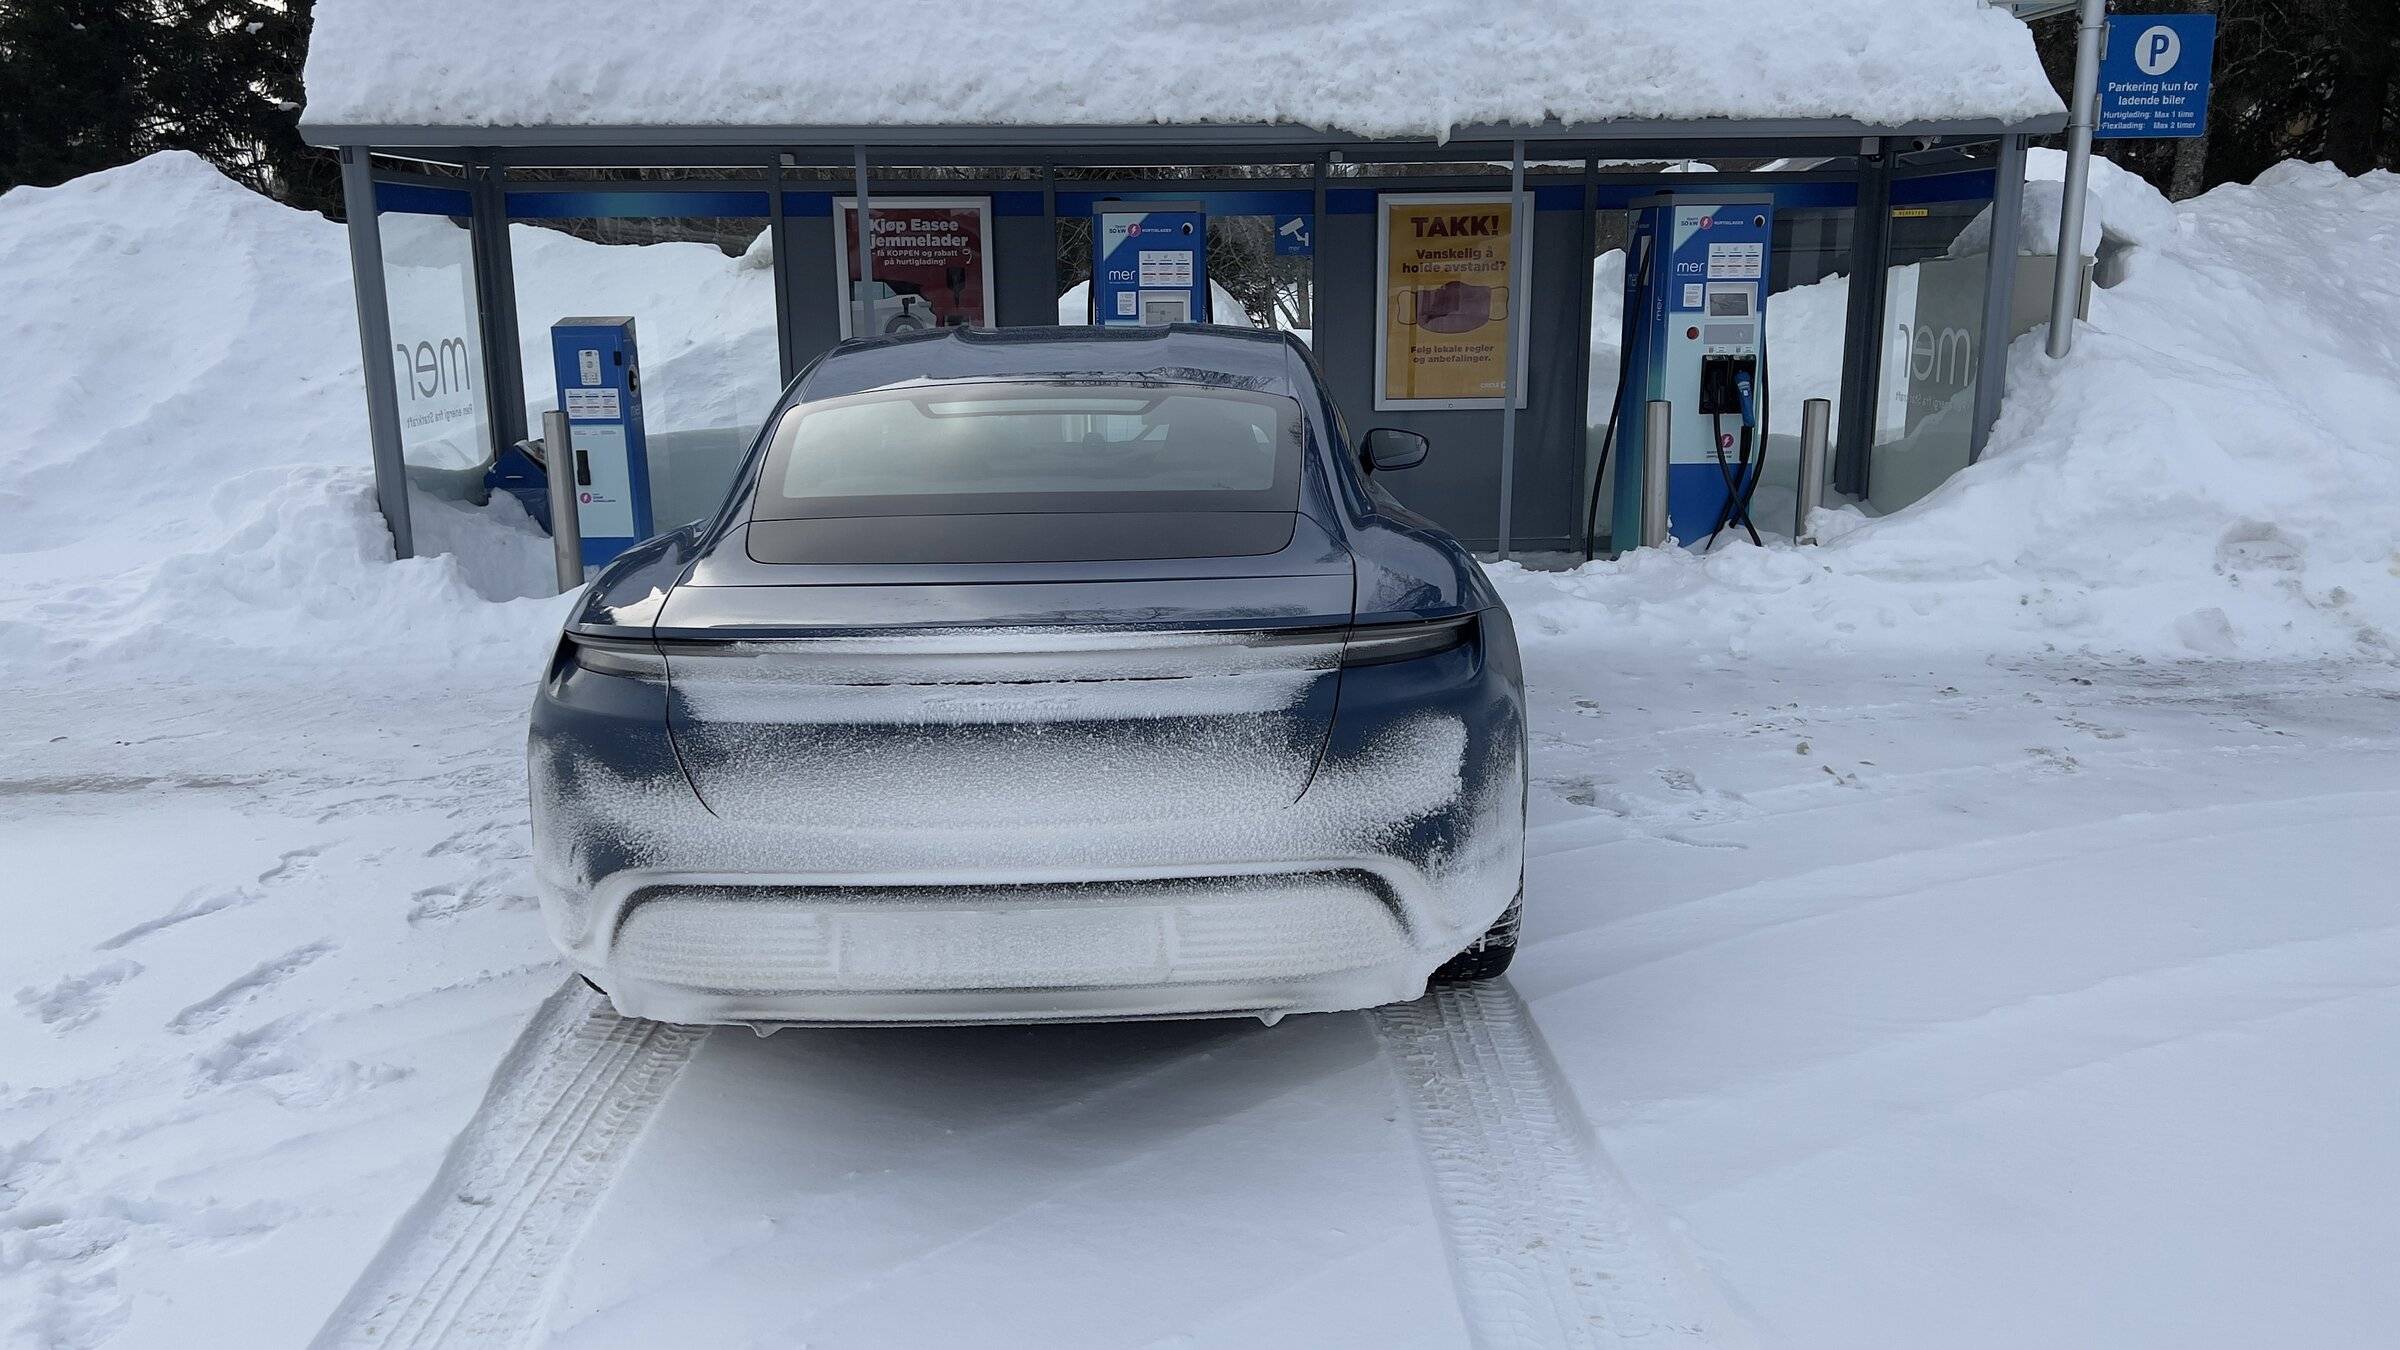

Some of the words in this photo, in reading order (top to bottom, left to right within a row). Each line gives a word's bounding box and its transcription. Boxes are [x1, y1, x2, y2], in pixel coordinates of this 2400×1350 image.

[2149, 34, 2170, 67] P
[2108, 82, 2159, 94] Parkering
[2161, 81, 2181, 92] kun
[2184, 81, 2199, 91] for
[2118, 95, 2160, 106] ladende
[2162, 95, 2186, 105] biler
[2103, 110, 2151, 121] Hurtiglading:
[2154, 110, 2169, 118] Max
[2172, 110, 2176, 118] 1
[2178, 110, 2194, 118] time
[2153, 121, 2168, 129] Max
[2170, 121, 2175, 129] 2
[2177, 121, 2196, 129] timer
[870, 218, 907, 234] Kjøp
[910, 218, 959, 232] Easee
[1410, 215, 1499, 238] TAKK!
[869, 233, 969, 250] jemmelader
[877, 248, 885, 257] få
[886, 248, 920, 257] KOPPEN
[921, 250, 932, 260] og
[934, 249, 958, 257] rabatt
[1415, 247, 1482, 261] Vanskelig
[1485, 245, 1494, 258] å
[884, 257, 895, 268] på
[896, 257, 947, 267] hurtiglading!
[1402, 261, 1441, 274] holde
[1444, 260, 1506, 273] avstand?
[1676, 262, 1705, 273] mer
[1108, 270, 1137, 281] mer
[1433, 345, 1461, 354] lokale
[1465, 344, 1495, 354] regler
[1412, 357, 1426, 365] og
[1428, 355, 1492, 364] anbefalinger.
